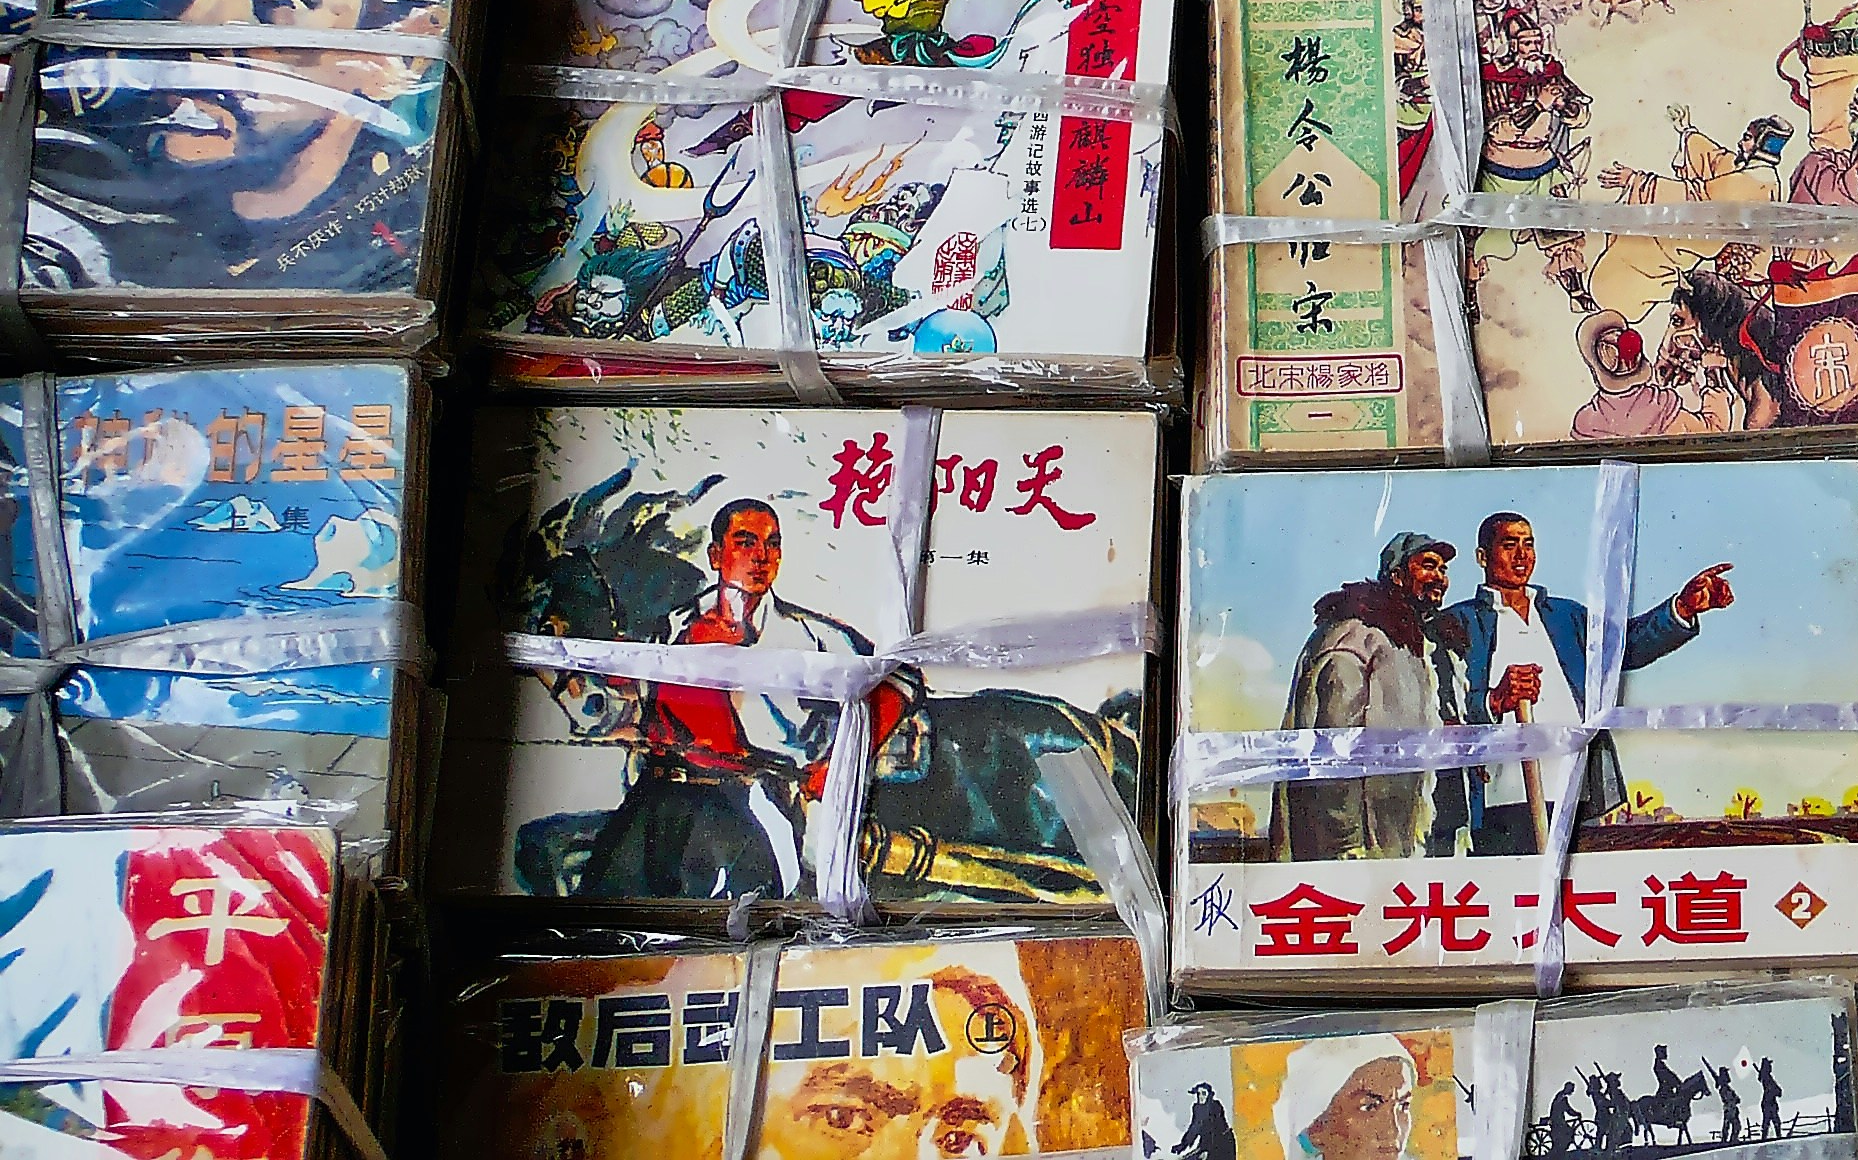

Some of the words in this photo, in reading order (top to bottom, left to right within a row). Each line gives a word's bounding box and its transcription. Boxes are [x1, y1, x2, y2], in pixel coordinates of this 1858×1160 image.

[1809, 332, 1850, 399] 宋
[819, 431, 1096, 530] 艳阳天
[230, 505, 310, 533] 上集
[1248, 871, 1750, 957] 金光大道
